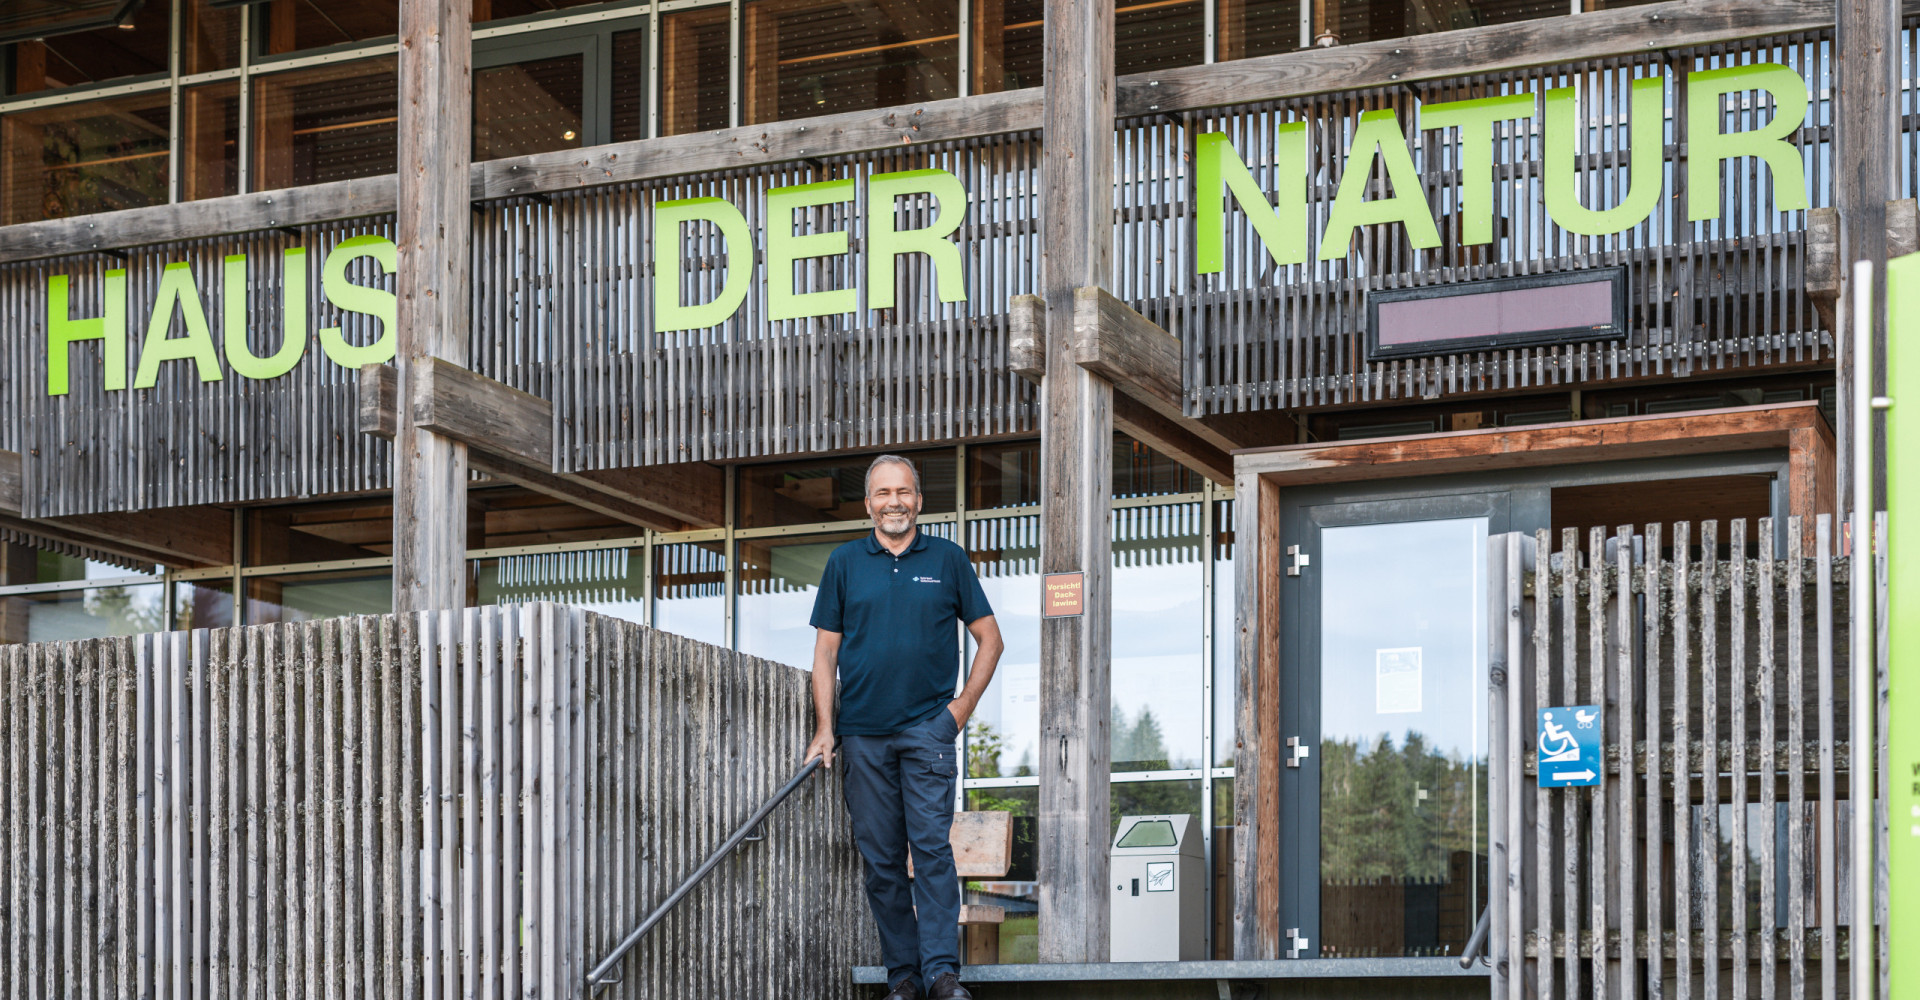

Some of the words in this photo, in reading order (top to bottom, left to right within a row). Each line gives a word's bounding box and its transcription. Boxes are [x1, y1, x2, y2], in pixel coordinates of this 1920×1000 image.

[48, 235, 397, 396] HAUS
[654, 168, 967, 333] DER
[1196, 62, 1810, 275] NATUR
[1047, 582, 1081, 591] Vorsicht!
[1054, 591, 1076, 599] Dach-
[1052, 599, 1078, 607] lawine
